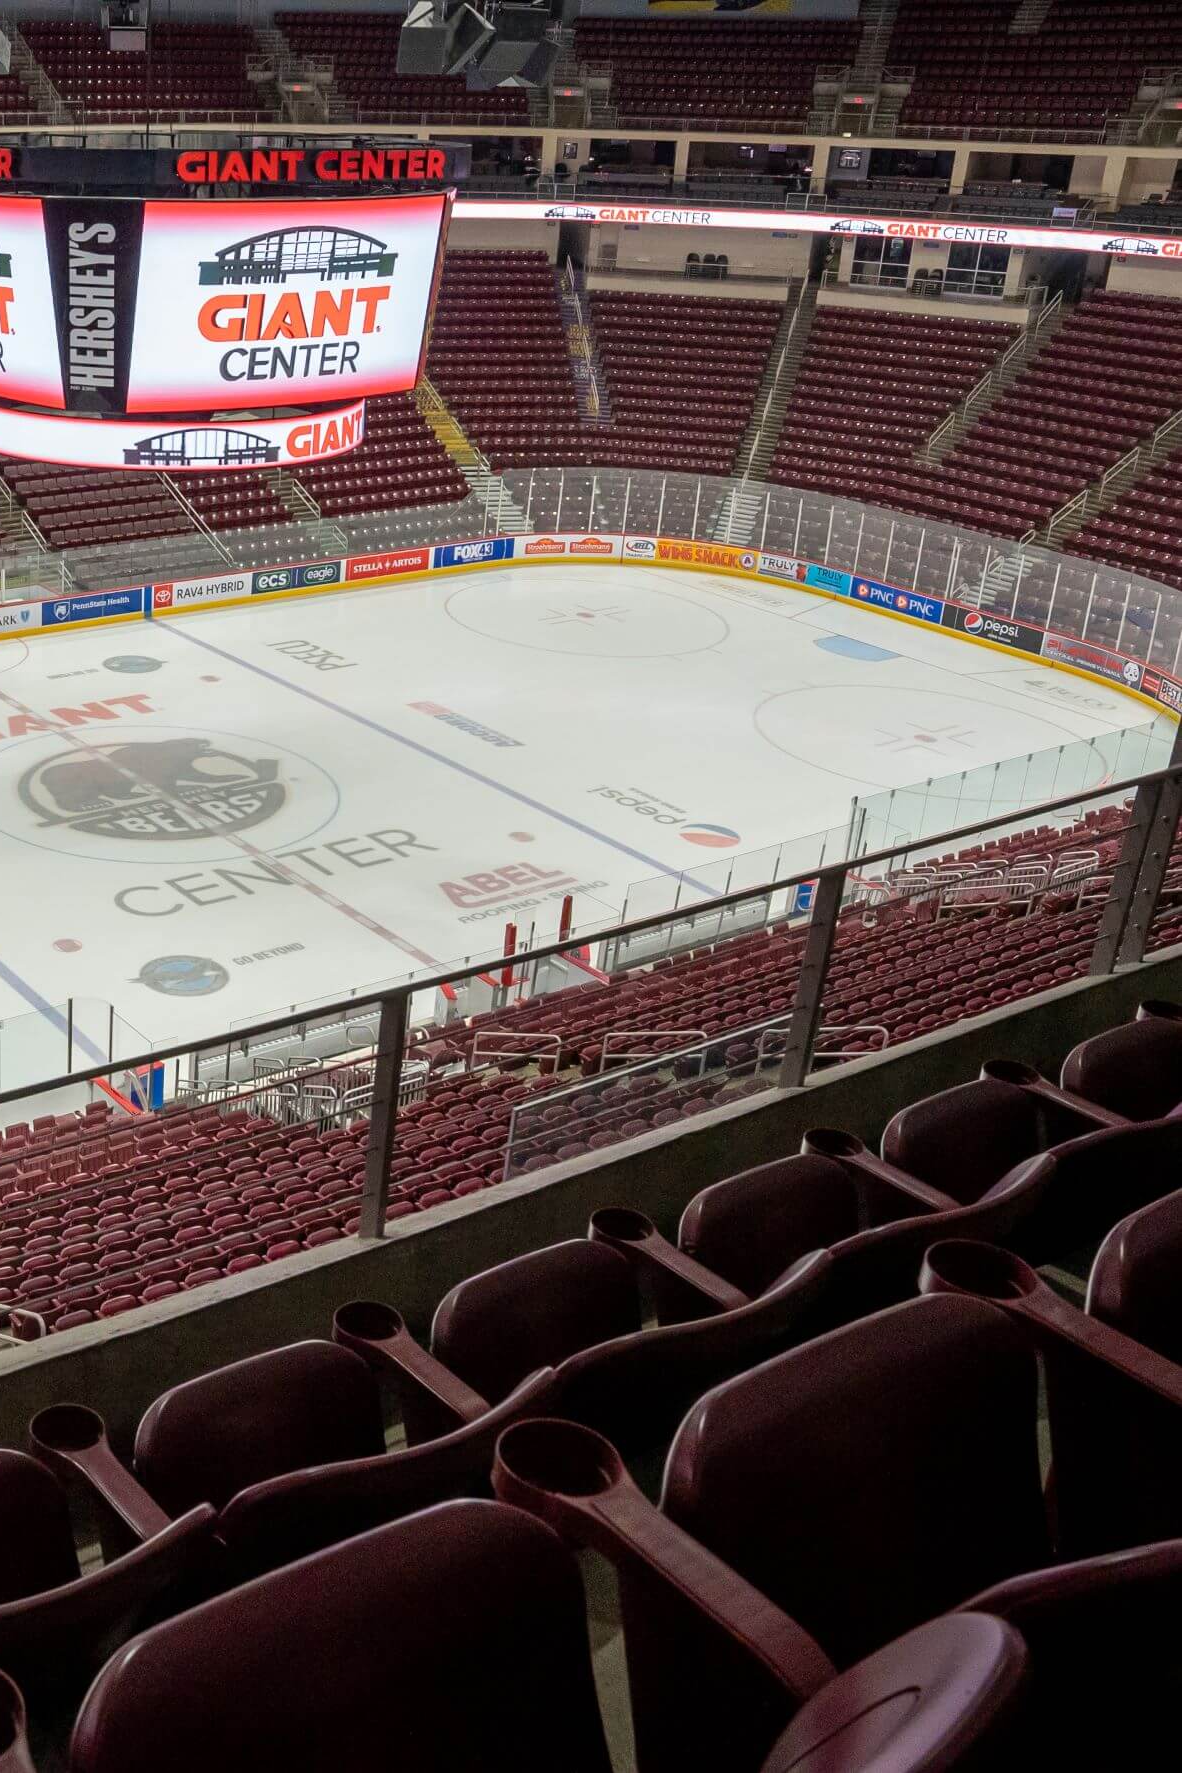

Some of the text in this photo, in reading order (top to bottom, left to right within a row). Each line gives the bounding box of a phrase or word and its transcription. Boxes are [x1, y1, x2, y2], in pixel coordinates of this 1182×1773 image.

[176, 149, 446, 183] GIANT CENTER
[599, 208, 711, 226] GIANT CENTER
[887, 223, 1008, 243] GIANT CENTER
[69, 222, 115, 387] HERSHEY'S
[198, 285, 390, 343] GIANT
[219, 341, 360, 382] CENTER
[286, 409, 363, 458] GIANT
[353, 556, 422, 574] STELLA ARTOIS
[658, 544, 692, 561] WING
[695, 548, 739, 569] SHACK
[761, 556, 795, 571] TRULY
[258, 566, 334, 587] ecs eagle
[817, 567, 843, 584] TRULY
[177, 580, 244, 600] RAV4 HYBRID
[870, 587, 934, 617] PNC PNC
[983, 619, 1019, 638] pepsi
[115, 792, 262, 833] BEARS
[586, 784, 686, 825] pepsi
[114, 829, 440, 917] CENTER
[439, 861, 565, 904] ABEL
[459, 897, 541, 925] ROOFING
[232, 941, 306, 968] GO BEYOND
